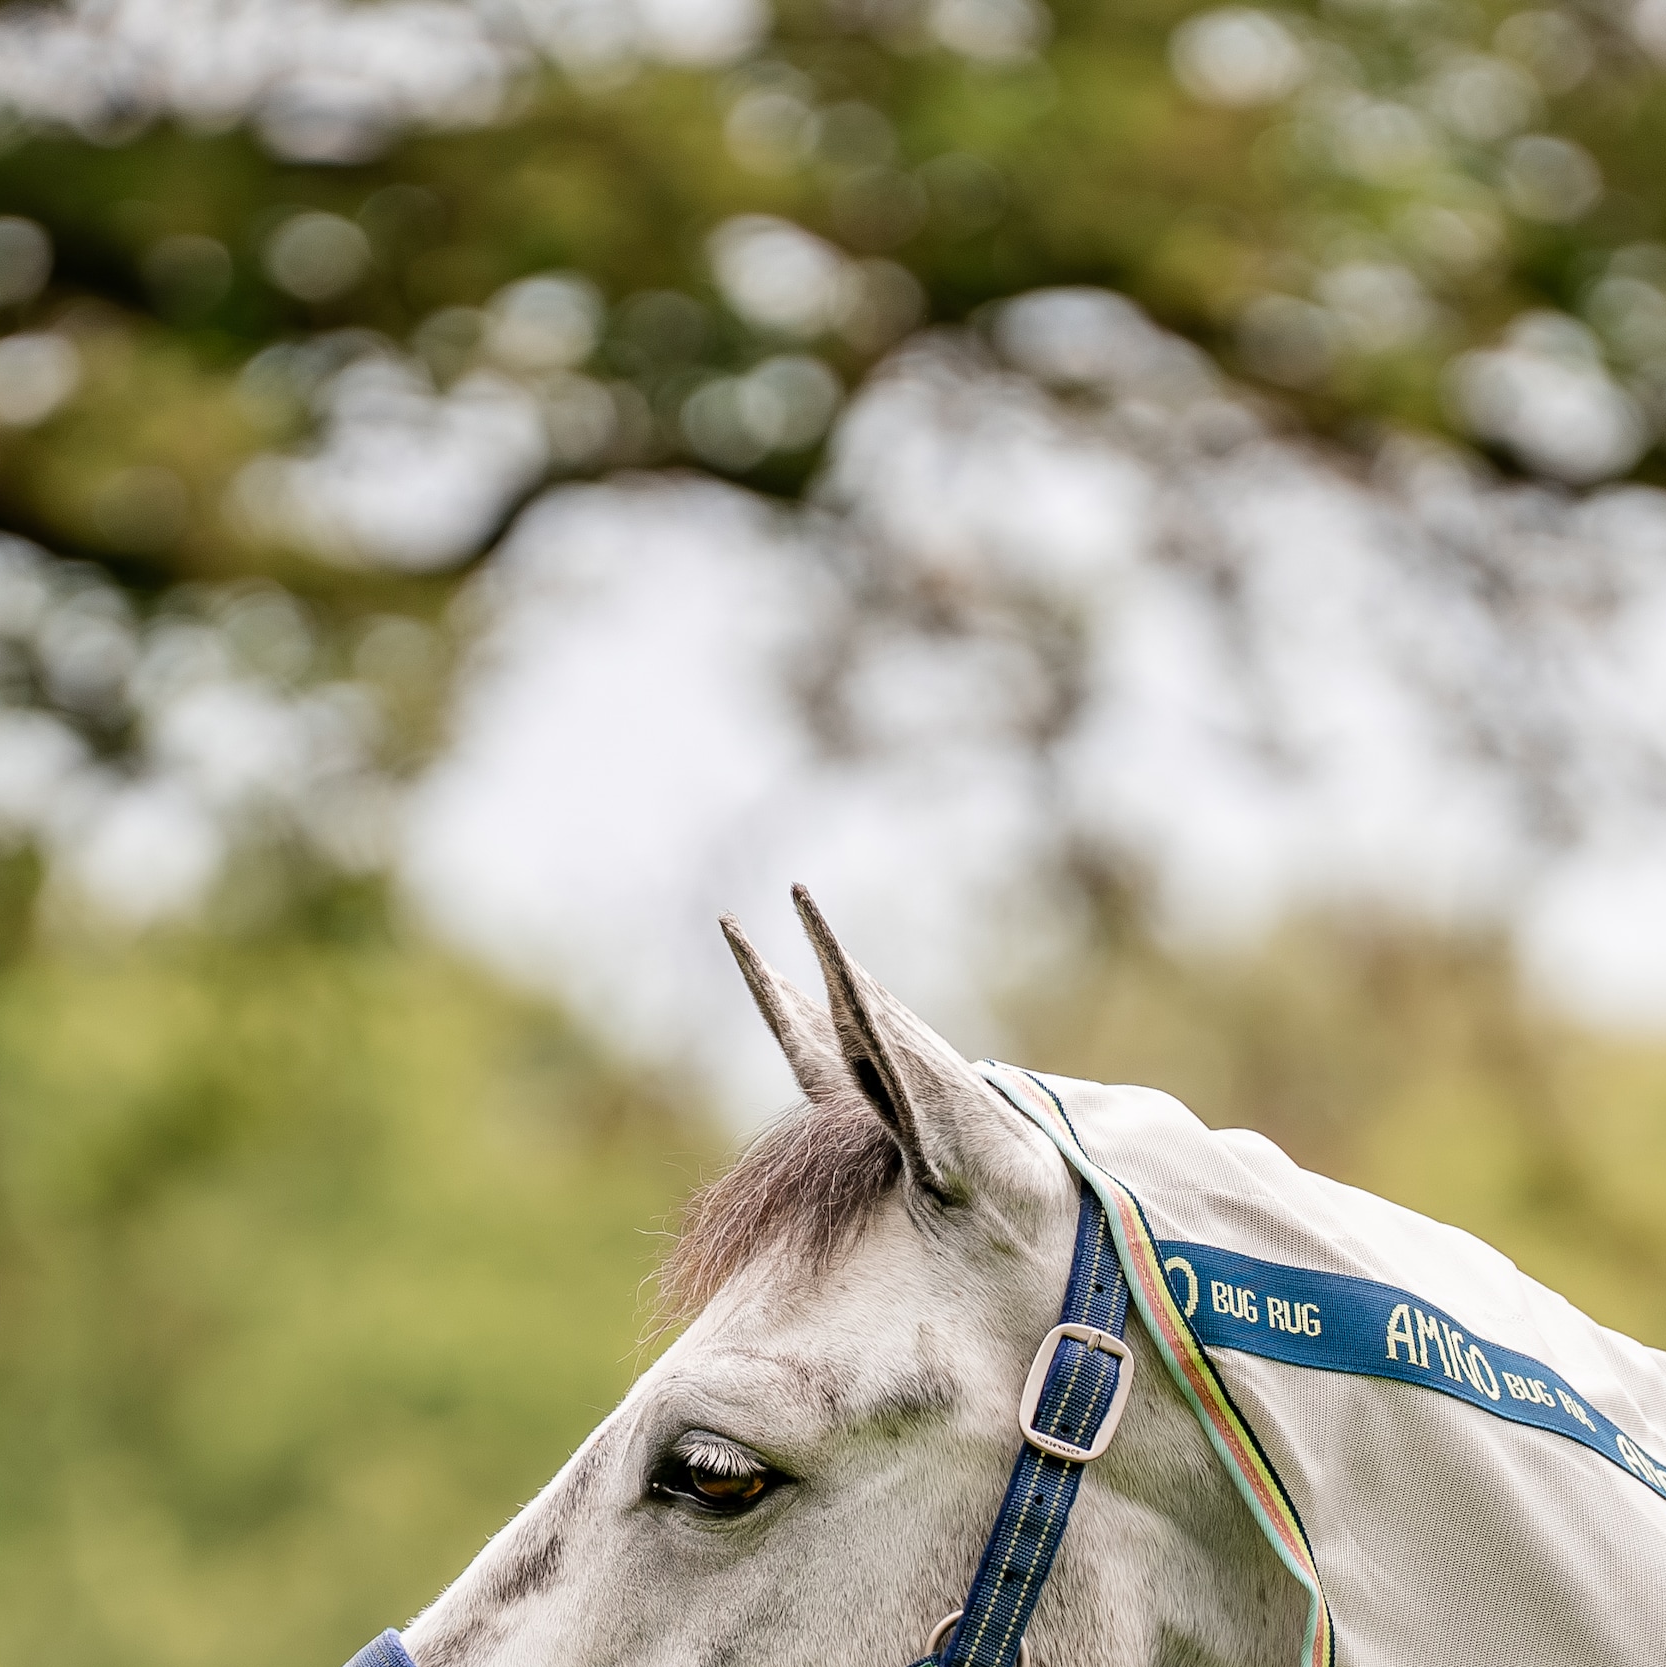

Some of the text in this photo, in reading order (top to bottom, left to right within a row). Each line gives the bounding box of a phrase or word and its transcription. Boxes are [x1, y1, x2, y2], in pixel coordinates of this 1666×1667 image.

[1211, 1280, 1259, 1324] BUG
[1267, 1295, 1322, 1338] RUG
[1385, 1303, 1501, 1401] AMIGO
[1502, 1371, 1556, 1409] BUG
